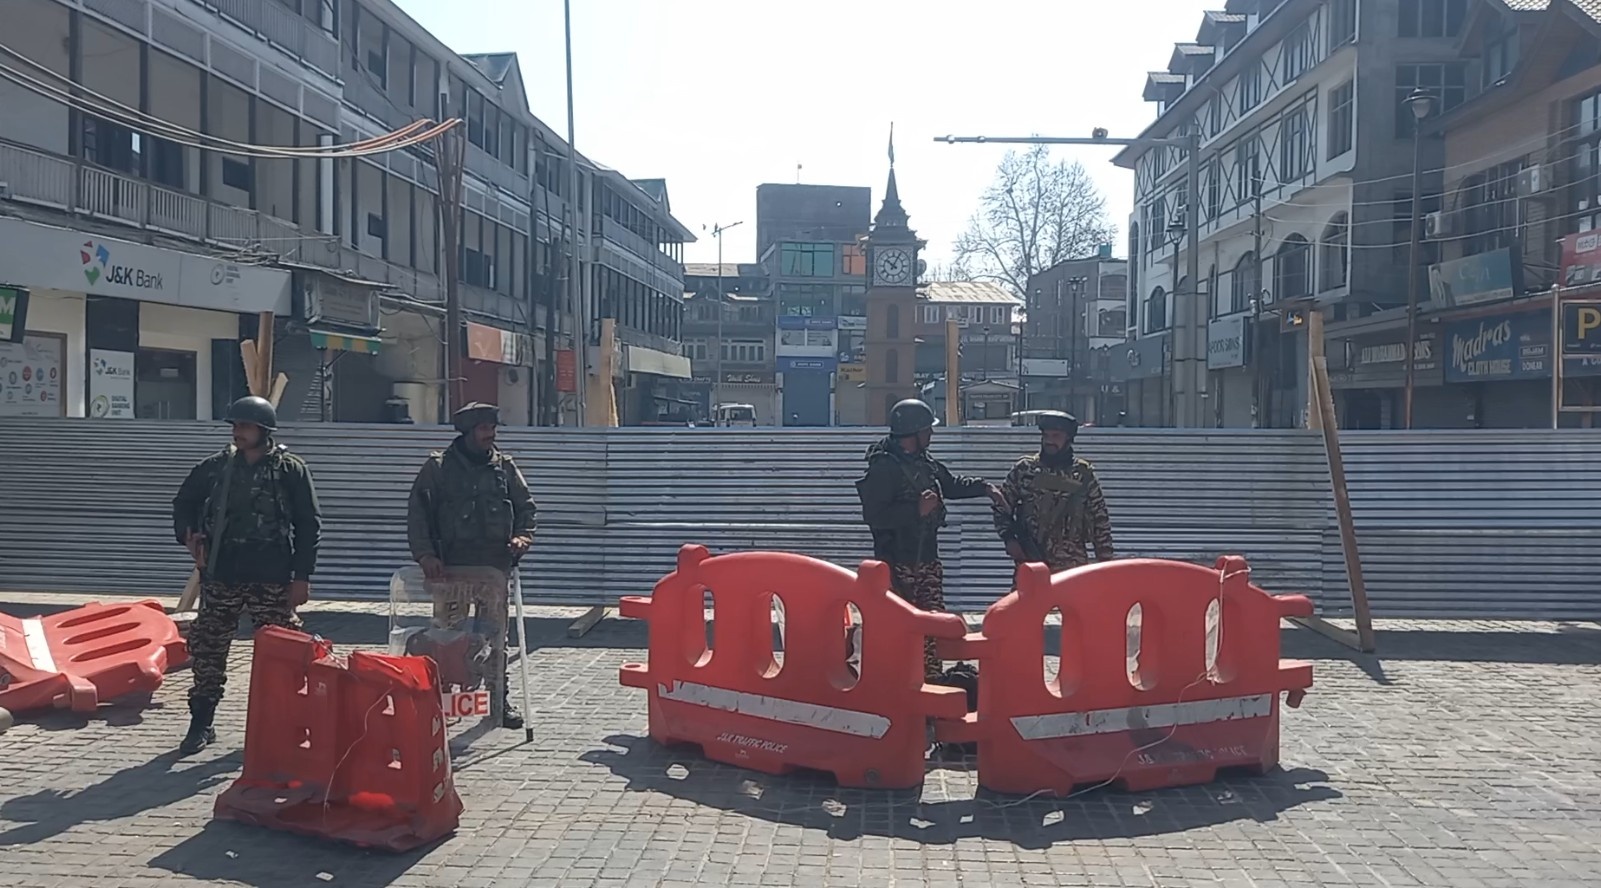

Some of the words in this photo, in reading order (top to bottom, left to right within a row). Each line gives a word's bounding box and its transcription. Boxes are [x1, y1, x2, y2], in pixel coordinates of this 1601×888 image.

[105, 264, 133, 286] J&K
[136, 269, 163, 290] Bank
[1452, 319, 1511, 373] Madras
[760, 740, 789, 754] POLICE
